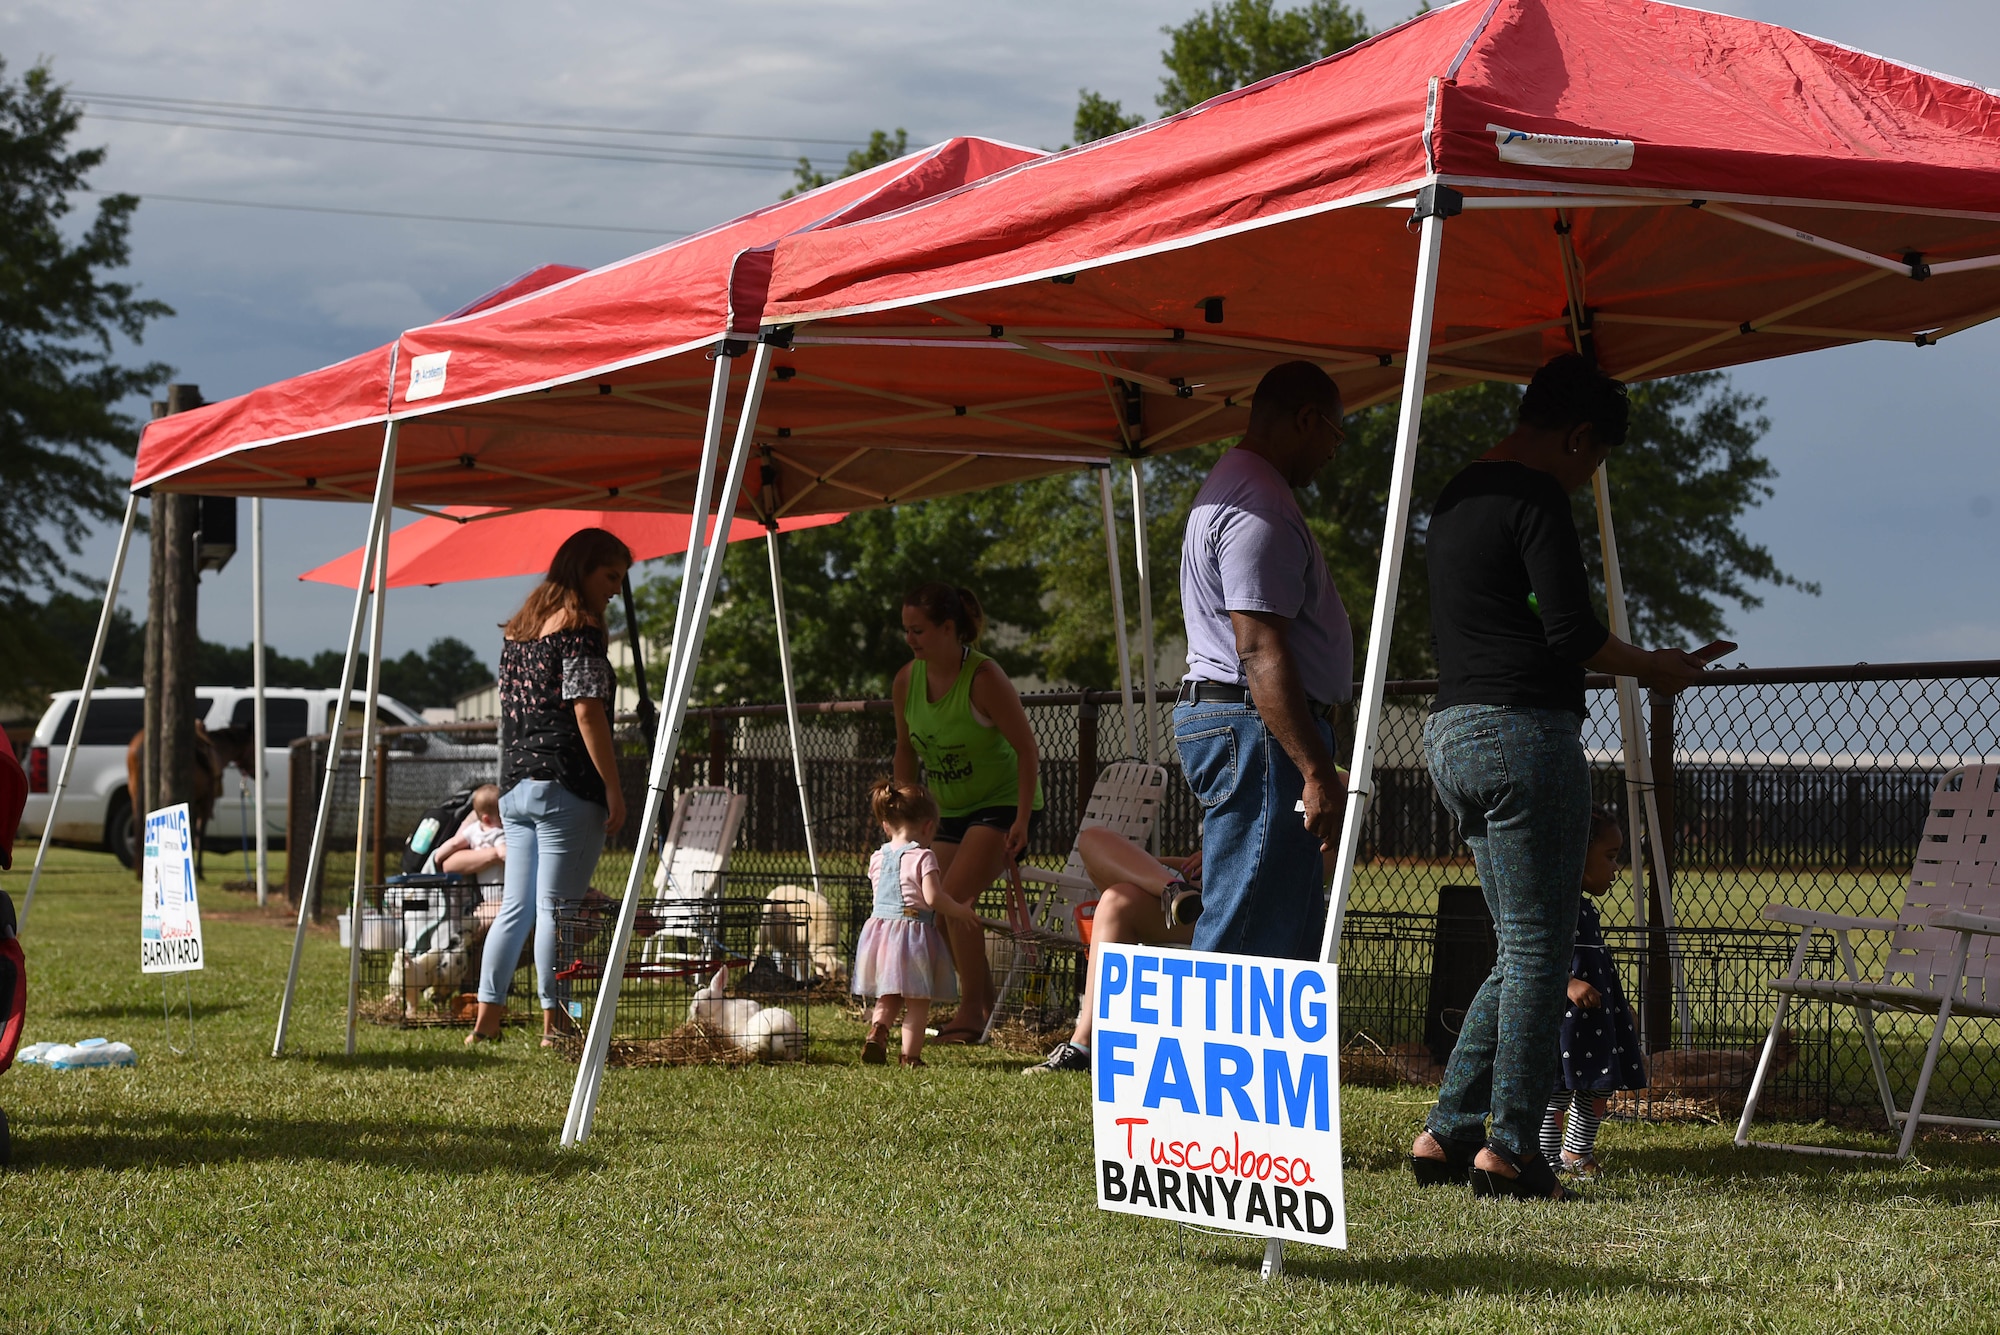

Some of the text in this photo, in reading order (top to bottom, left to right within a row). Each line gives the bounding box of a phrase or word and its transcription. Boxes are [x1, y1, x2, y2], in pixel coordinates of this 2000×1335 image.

[143, 938, 200, 966] BARNYARD
[1099, 952, 1328, 1043] PETTING
[1097, 1029, 1331, 1133] FARM
[1115, 1117, 1316, 1187] Tuscaloosa
[1102, 1159, 1334, 1235] BARNYARD
